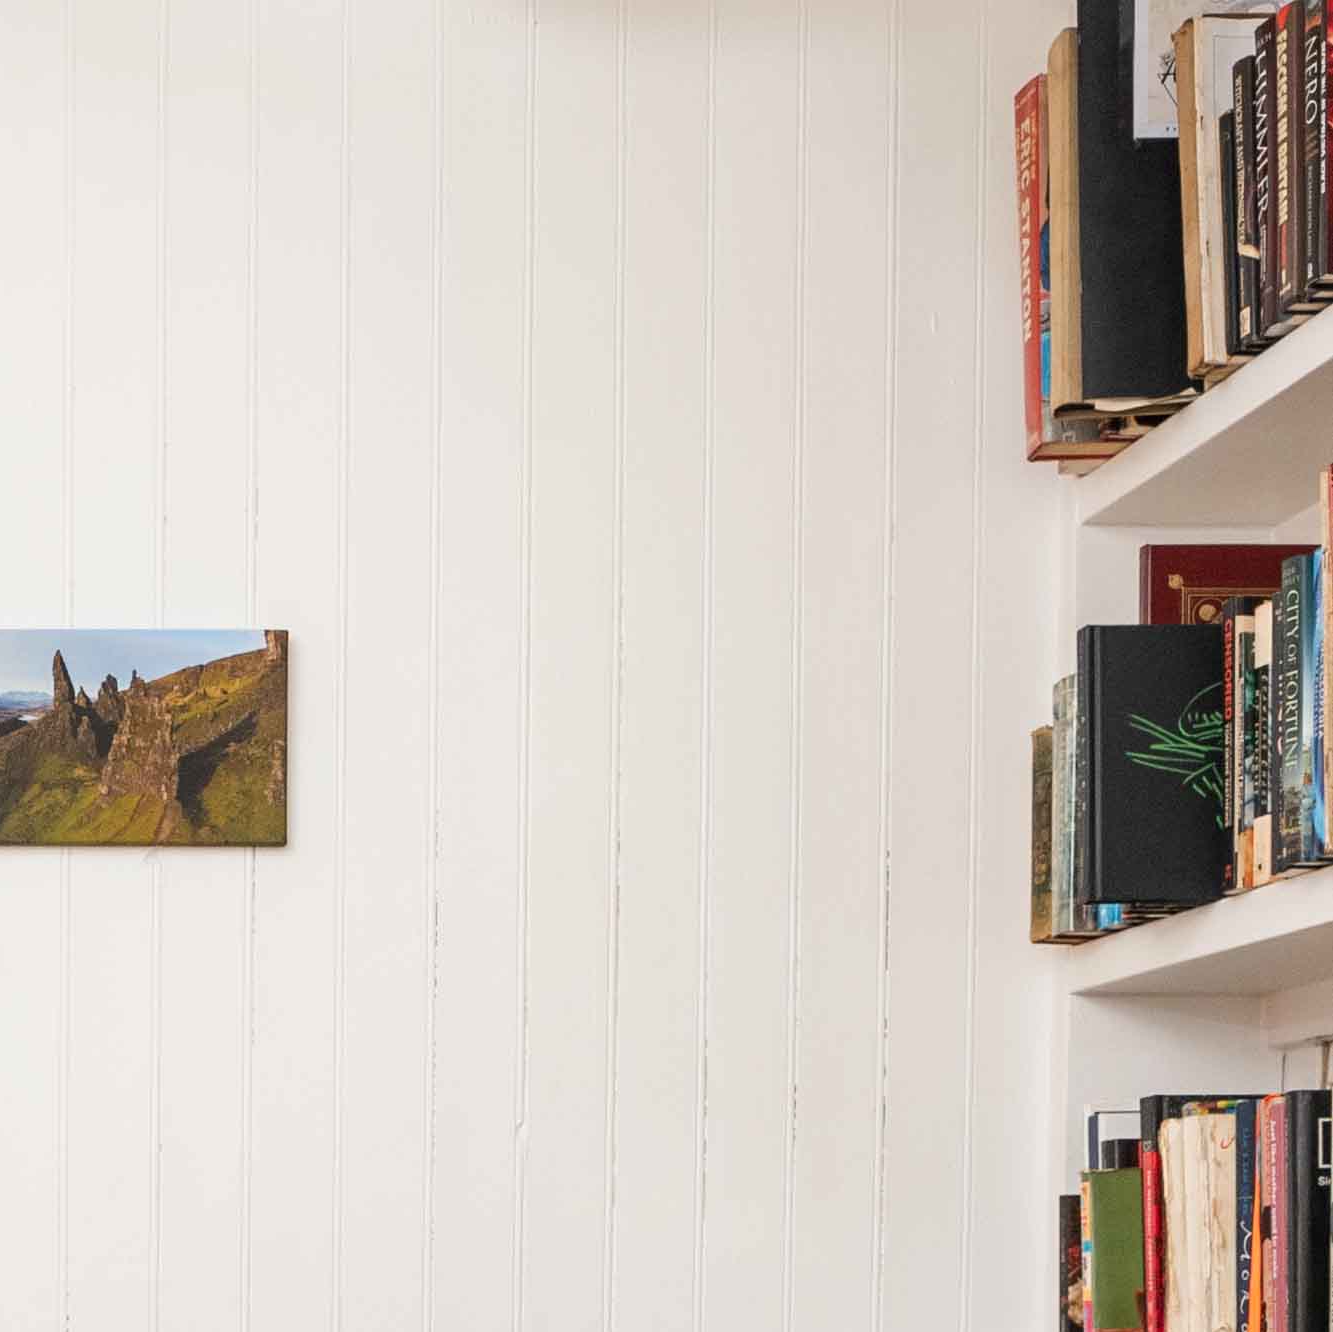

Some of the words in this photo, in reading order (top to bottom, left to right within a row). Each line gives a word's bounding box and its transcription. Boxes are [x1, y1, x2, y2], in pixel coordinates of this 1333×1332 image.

[1276, 29, 1287, 119] FASCISM
[1304, 35, 1318, 125] NERO
[1019, 117, 1031, 192] ERIC
[1254, 50, 1269, 222] HIMMLER
[1278, 142, 1289, 226] BRITAIN
[1020, 196, 1032, 343] STANTON
[1286, 590, 1299, 638] CITY
